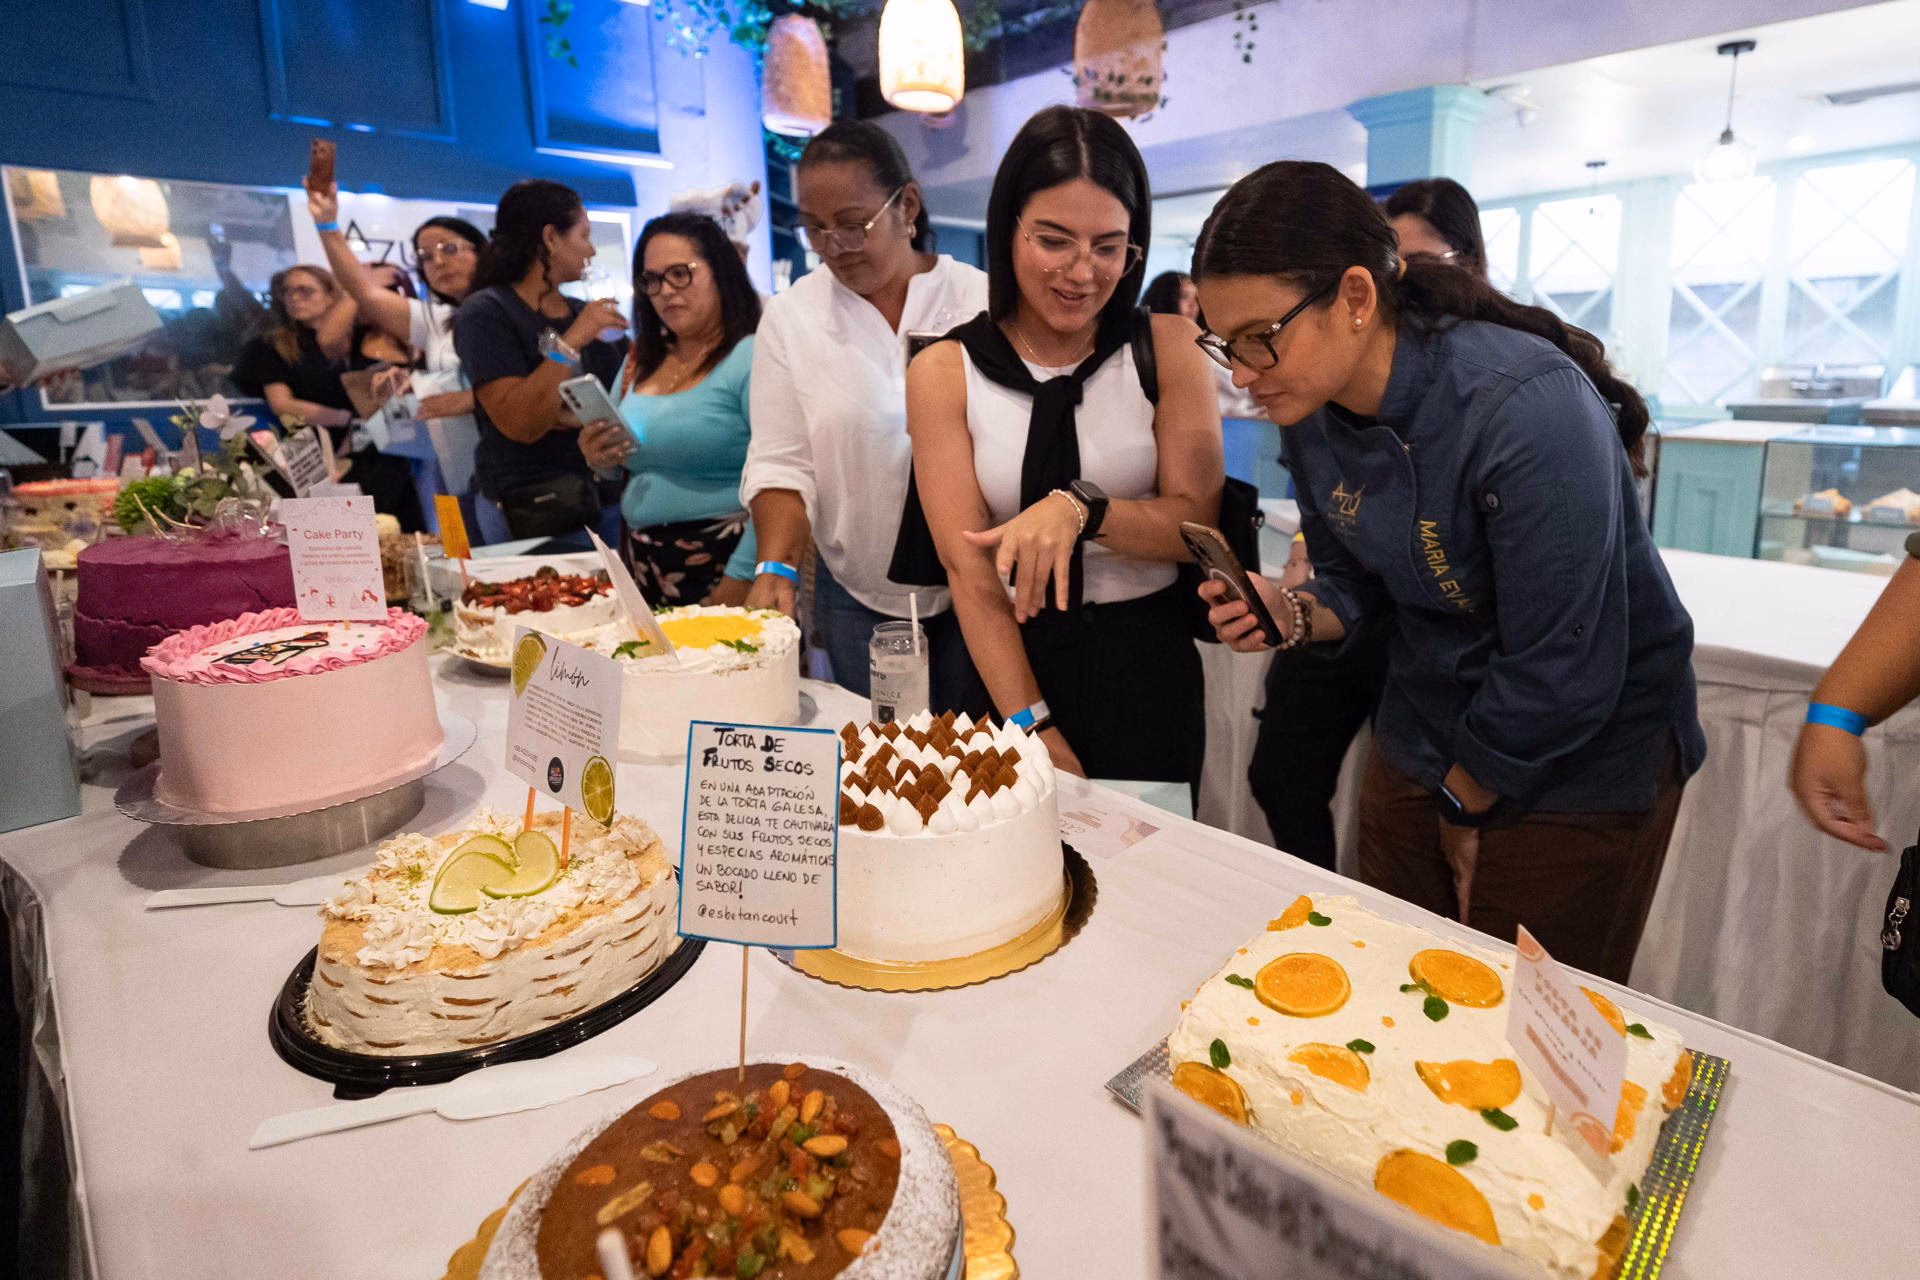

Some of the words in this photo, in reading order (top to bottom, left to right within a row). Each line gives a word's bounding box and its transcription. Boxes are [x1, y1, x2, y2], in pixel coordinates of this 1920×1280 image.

[303, 530, 332, 539] Cake
[334, 529, 363, 540] Party
[1420, 520, 1450, 577] MARIA
[713, 728, 756, 748] TORTA
[760, 735, 786, 752] DE
[702, 748, 754, 772] FRUTOS
[763, 756, 814, 775] SECOS
[700, 780, 716, 790] EN
[720, 782, 740, 793] UNA
[700, 794, 711, 807] DE
[717, 797, 728, 807] LA
[731, 797, 766, 810] TORTA
[698, 811, 719, 822] ESTA
[725, 813, 760, 826] DELICIA
[765, 818, 778, 829] TE
[697, 826, 717, 839] CON
[722, 829, 744, 840] SUS
[752, 831, 793, 846] FRUTOS
[797, 836, 832, 847] SECOS
[697, 843, 704, 857] Y
[707, 844, 763, 861] ESPECIAS
[696, 863, 712, 876] UN
[716, 863, 758, 880] BOCADO
[763, 870, 797, 883] LLENO
[803, 873, 821, 885] DE
[696, 880, 743, 899] SABOR!
[697, 903, 798, 925] @esbetancourt
